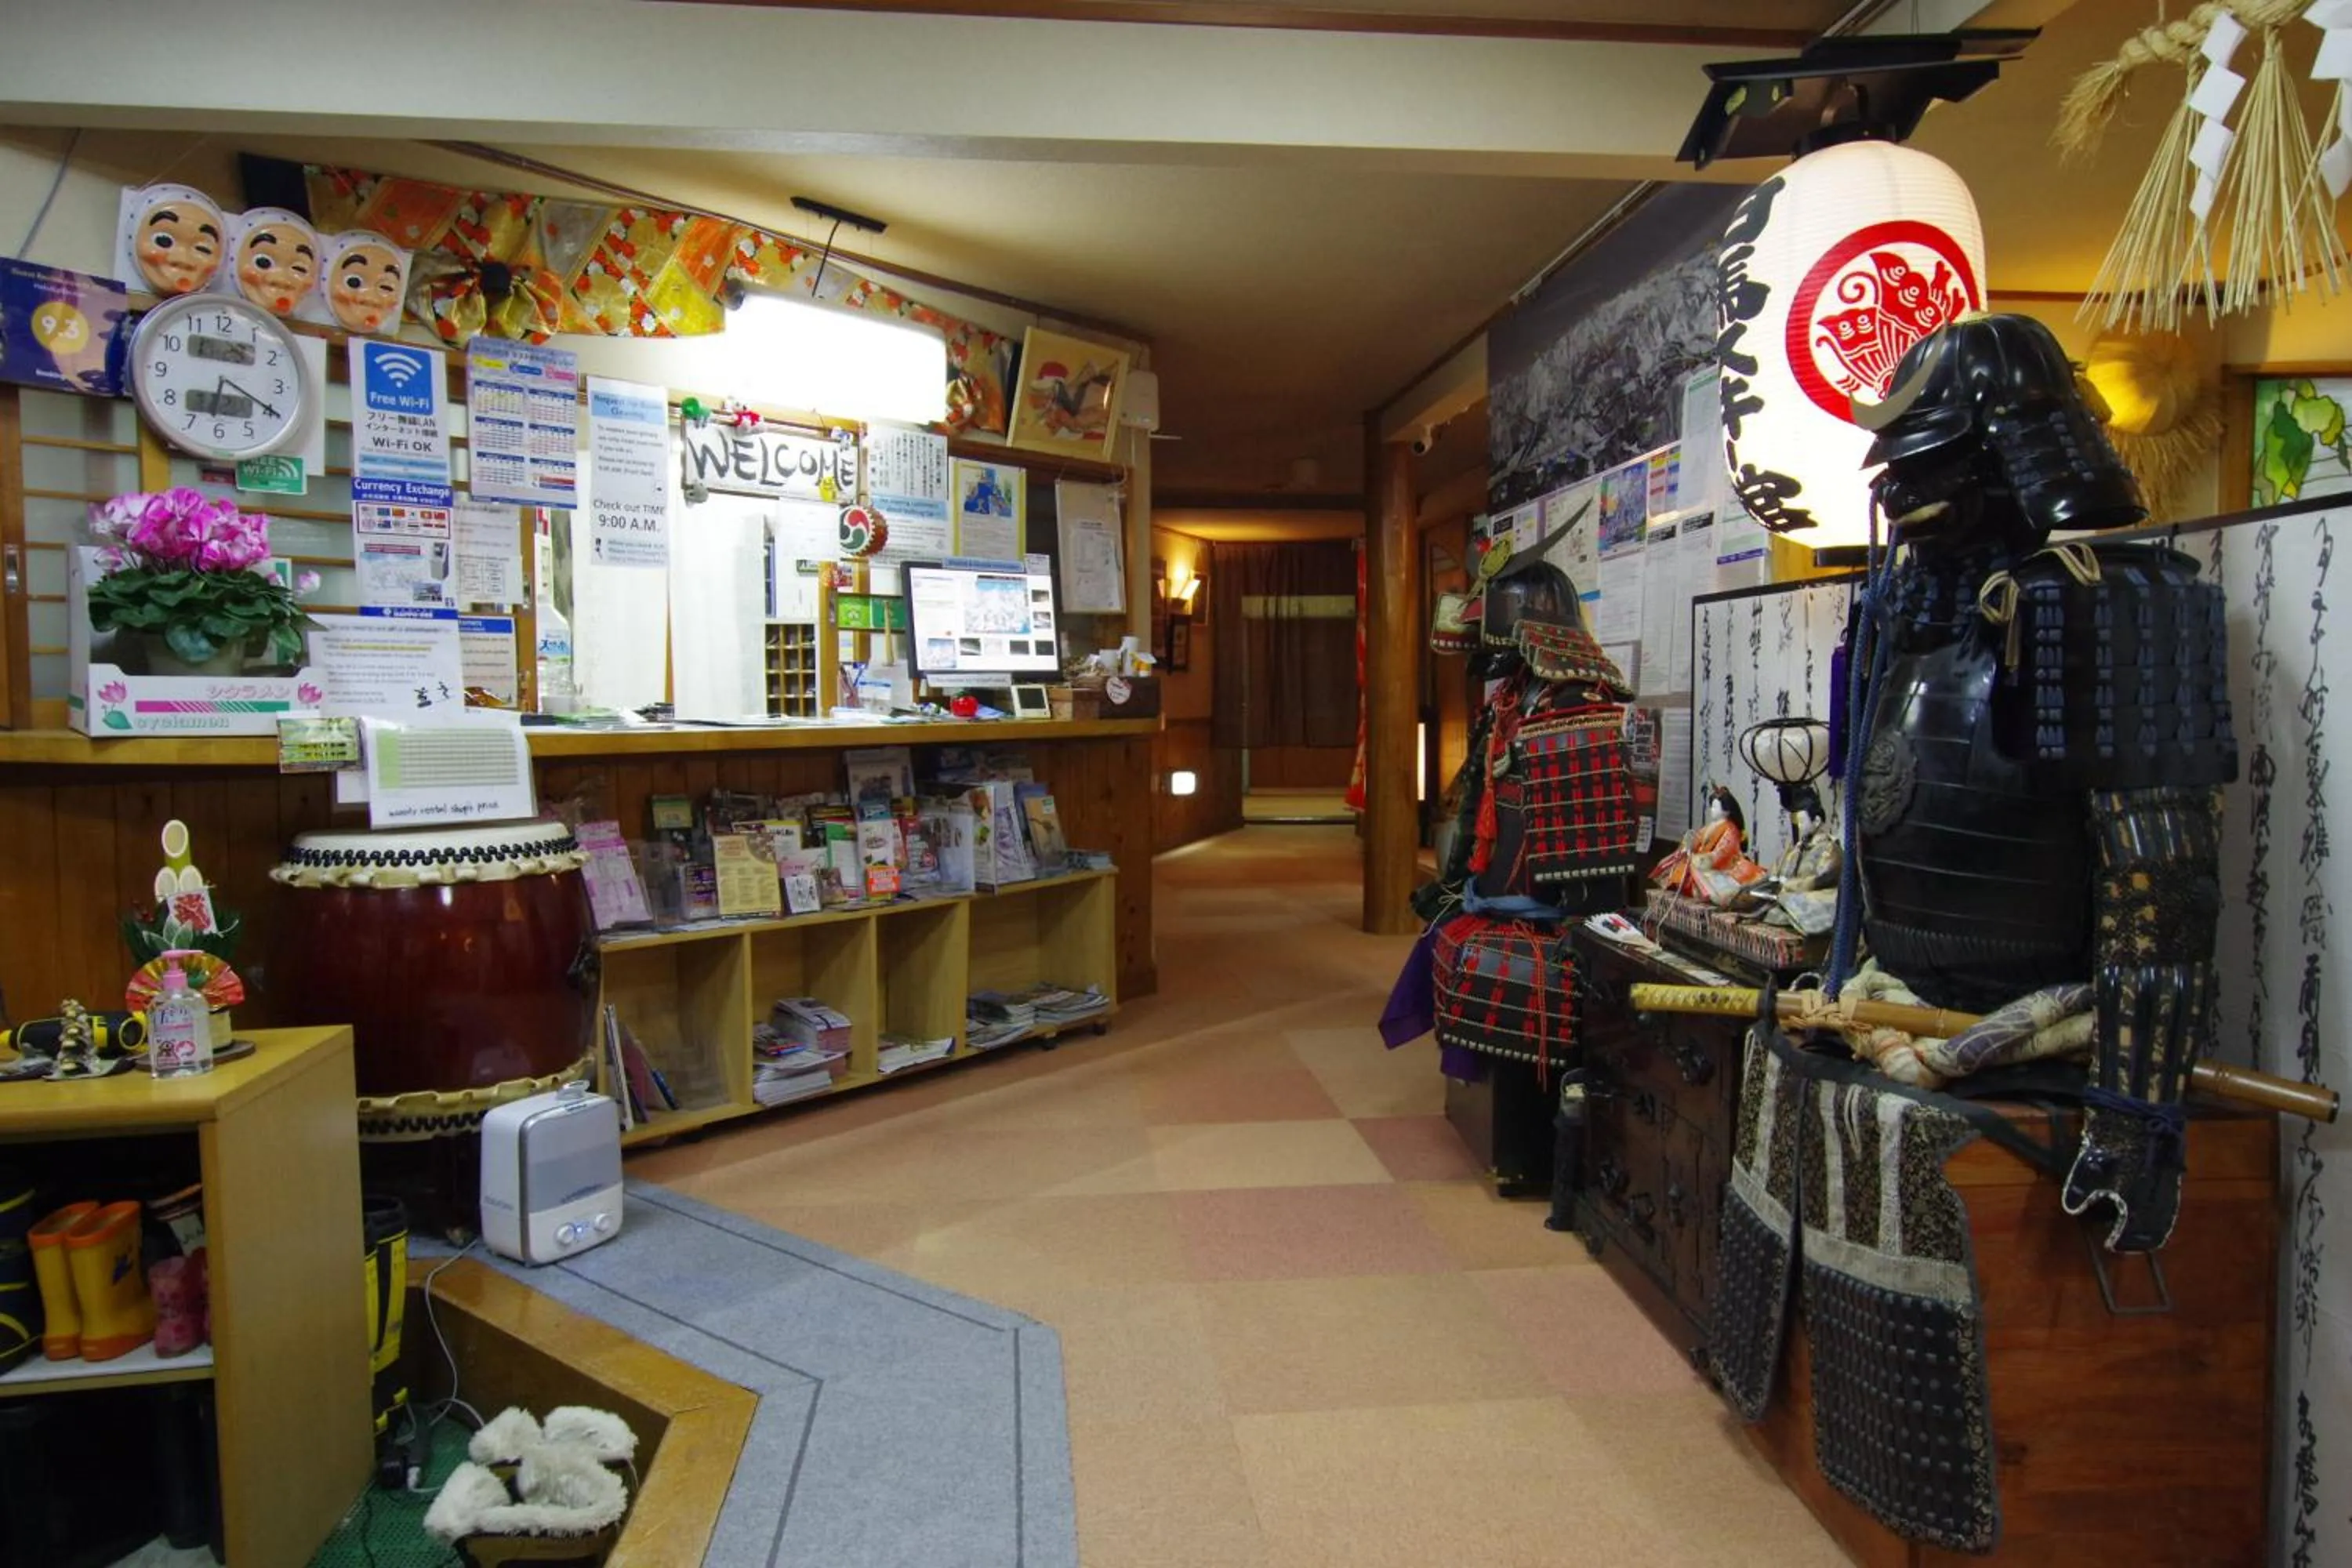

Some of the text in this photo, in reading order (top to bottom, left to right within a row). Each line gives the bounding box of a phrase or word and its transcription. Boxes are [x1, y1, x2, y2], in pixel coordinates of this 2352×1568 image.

[42, 315, 80, 339] 9.3
[187, 314, 201, 332] 11
[216, 315, 232, 332] 12
[163, 334, 181, 352] 10
[252, 327, 259, 343] 1
[267, 350, 278, 366] 2
[154, 361, 167, 377] 9
[274, 379, 284, 394] 3
[164, 390, 176, 405] 8
[370, 391, 430, 409] Free Wi-Fi
[185, 413, 196, 429] 7
[243, 421, 254, 437] 5
[213, 423, 225, 439] 6
[372, 436, 433, 452] Wi-Fi OK
[687, 429, 855, 492] WELCOME
[354, 478, 451, 497] Currency Exchange
[593, 499, 666, 516] Check out TIME
[598, 514, 661, 533] 9:00 A.M.
[206, 684, 290, 699] シクラメン
